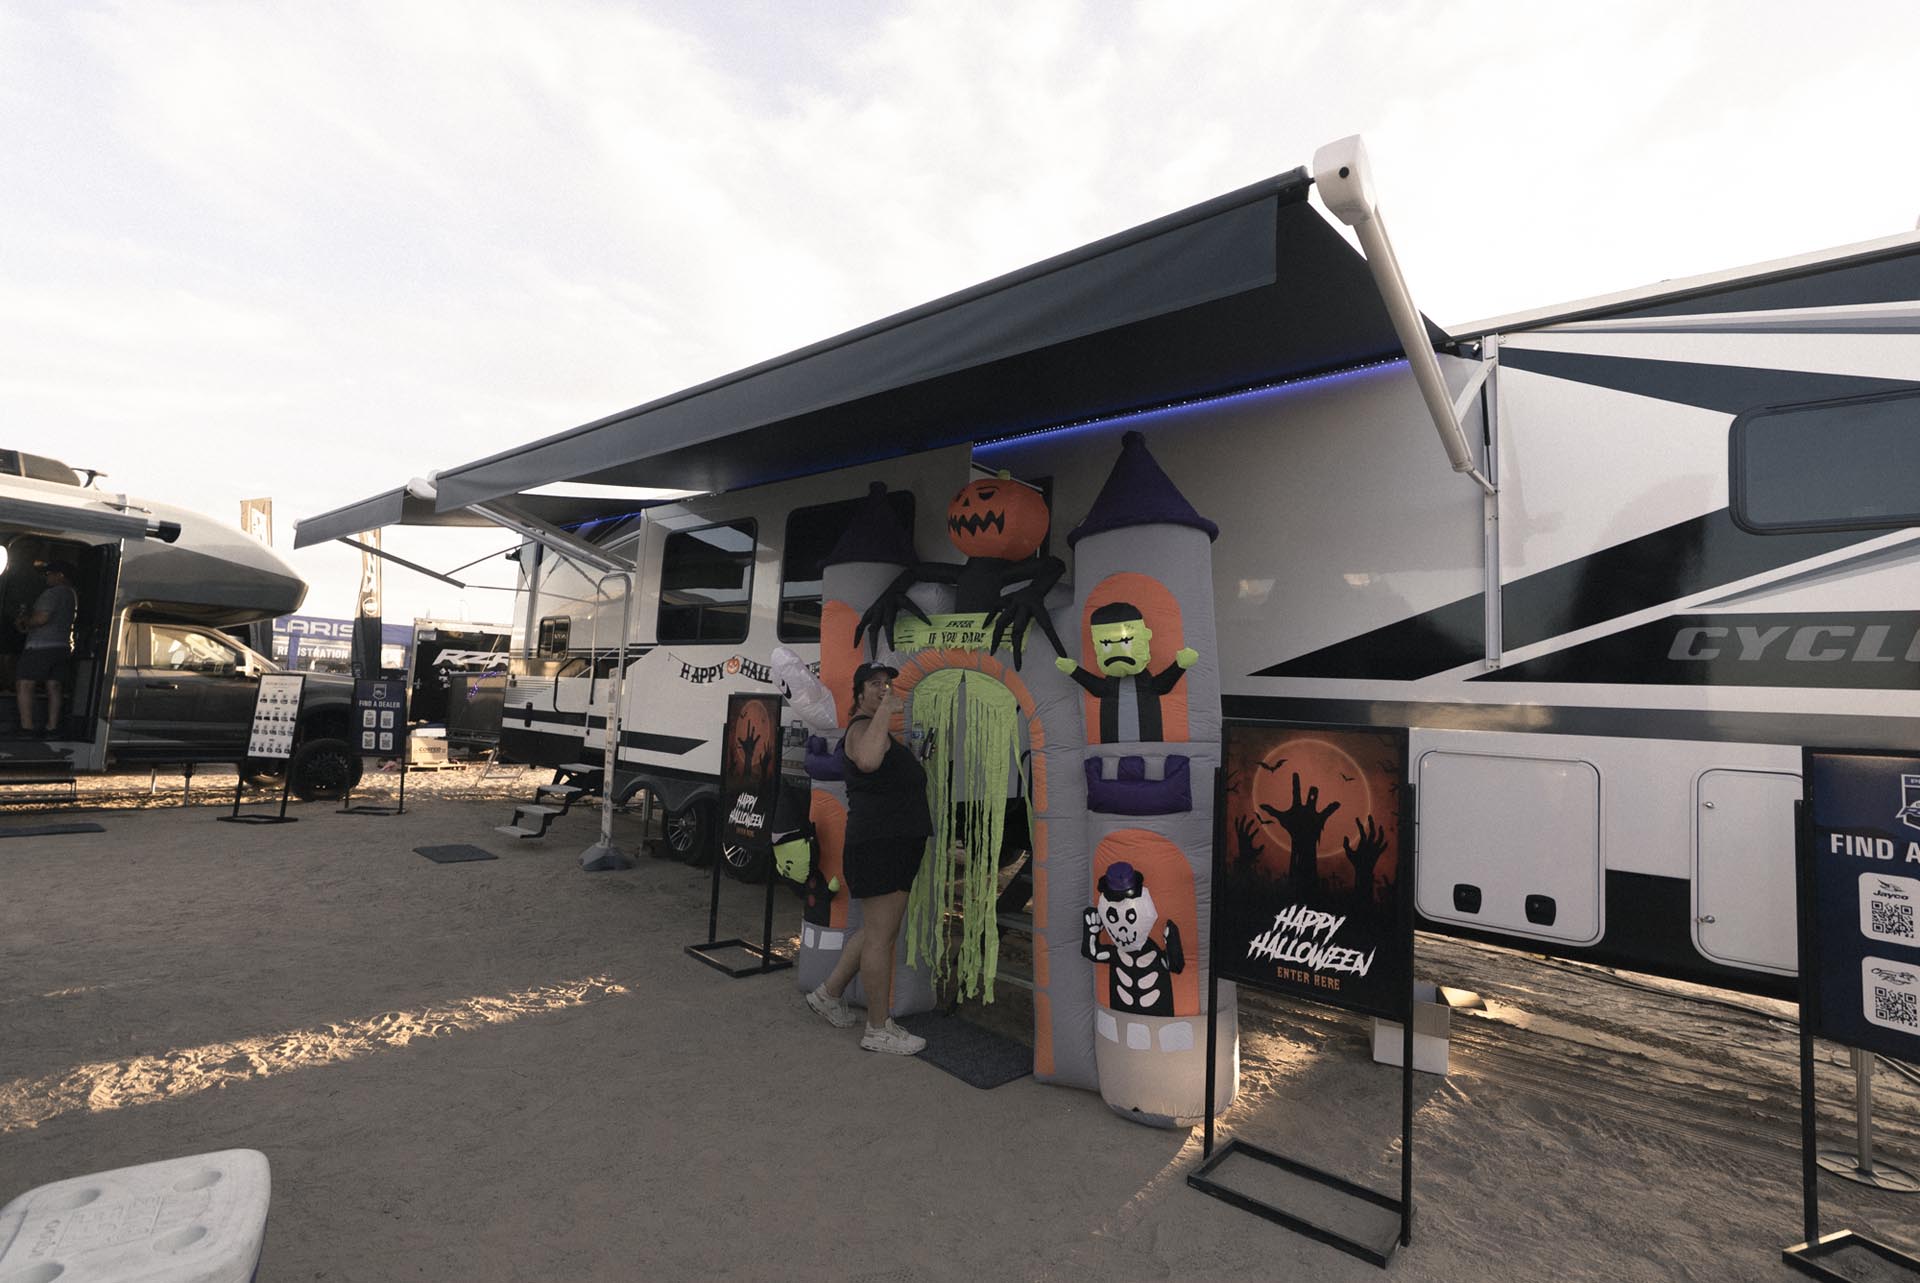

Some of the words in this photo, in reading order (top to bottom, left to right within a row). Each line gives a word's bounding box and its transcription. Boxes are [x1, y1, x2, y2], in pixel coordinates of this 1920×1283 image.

[928, 632, 937, 645] IF
[942, 631, 957, 645] YOU
[680, 662, 724, 684] HAPPY
[735, 792, 758, 813] HAPPY
[728, 807, 766, 829] HALLOWEEN
[1830, 832, 1895, 860] FIND
[1872, 889, 1910, 901] Jayco
[1273, 904, 1347, 946] HAPPY
[1246, 930, 1377, 977] HALLOWEEN
[1277, 966, 1310, 985] ENTER
[1314, 974, 1341, 991] HERE
